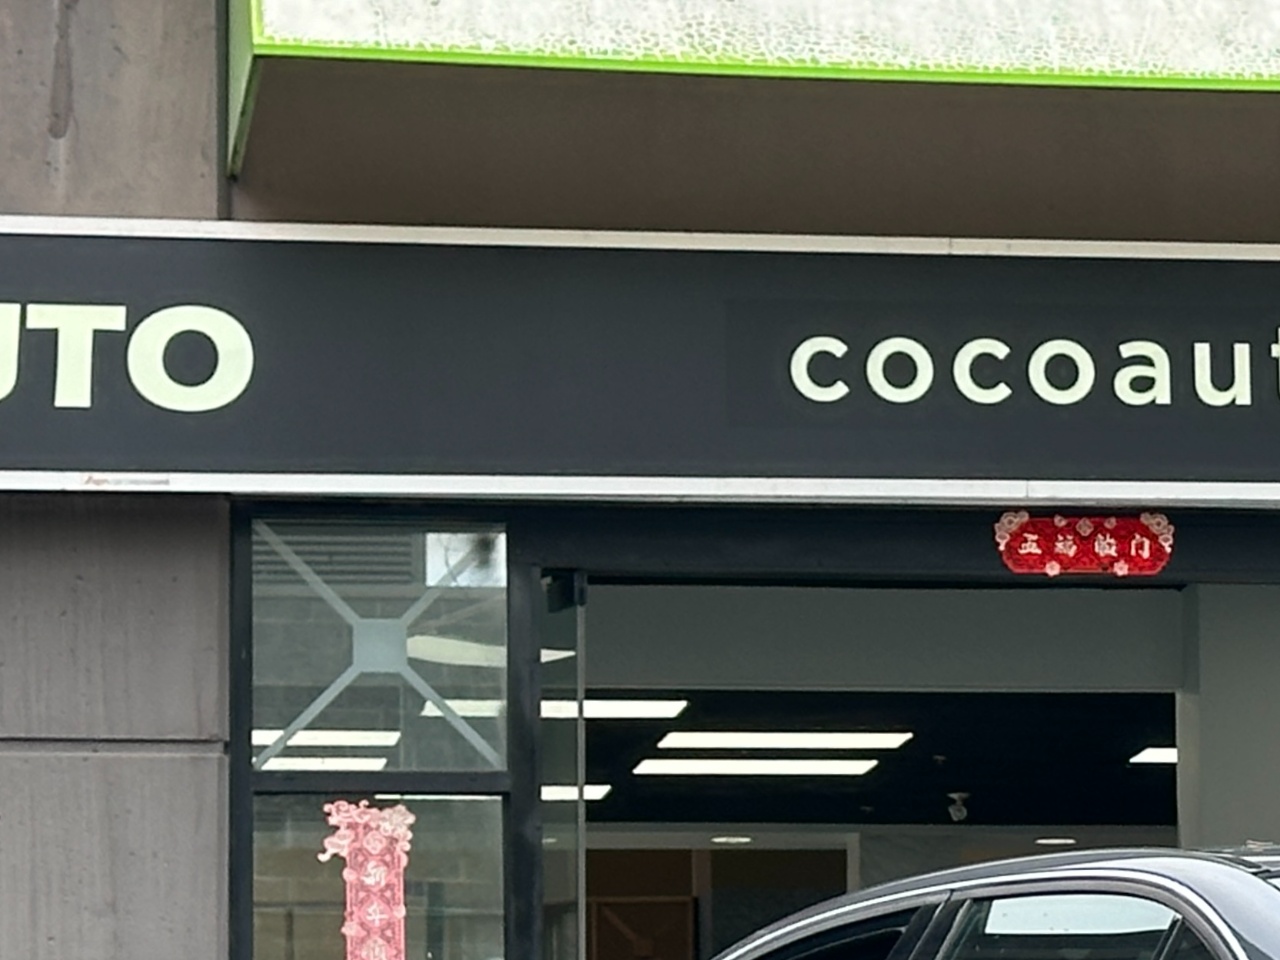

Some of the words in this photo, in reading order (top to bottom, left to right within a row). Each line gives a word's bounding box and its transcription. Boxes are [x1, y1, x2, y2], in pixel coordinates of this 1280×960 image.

[0, 303, 253, 411] TO
[1017, 532, 1151, 560] 五福临门
